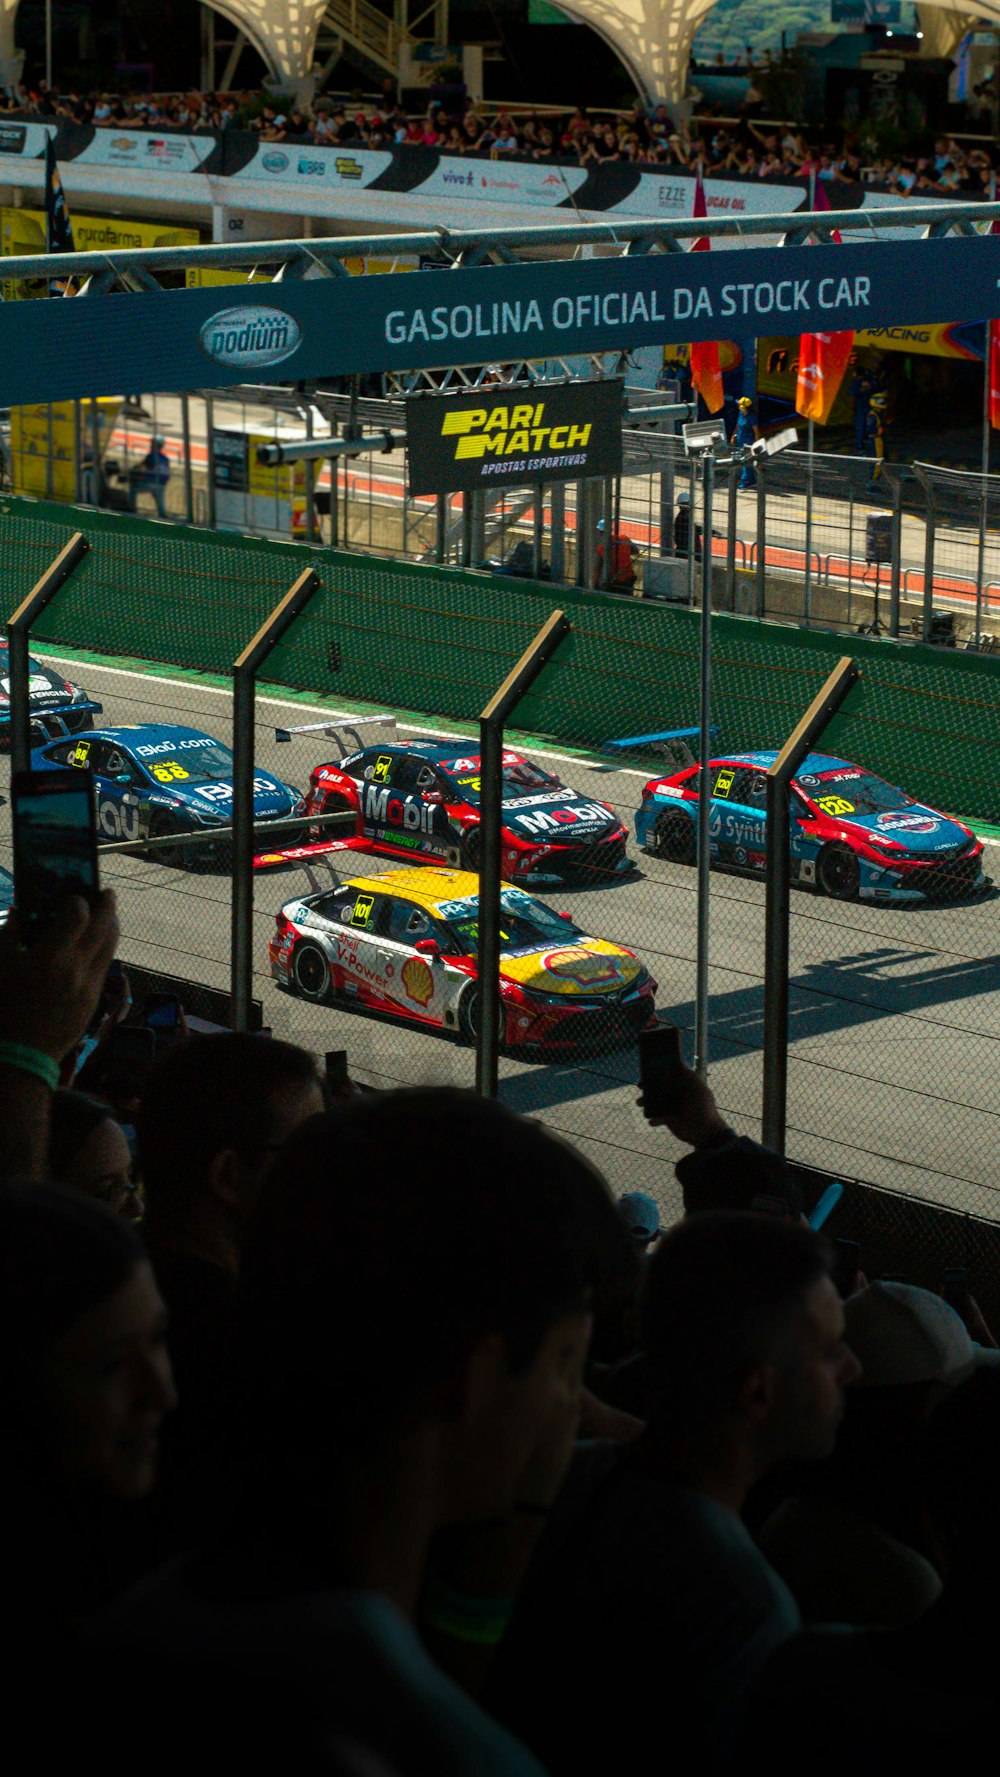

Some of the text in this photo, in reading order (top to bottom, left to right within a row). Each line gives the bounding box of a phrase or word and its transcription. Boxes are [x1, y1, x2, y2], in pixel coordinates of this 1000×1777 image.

[307, 161, 326, 175] BRB
[443, 171, 464, 184] vivo
[658, 186, 685, 202] EZZE
[706, 196, 746, 210] UCAS OIL
[77, 226, 142, 247] eurofarma
[384, 276, 871, 344] GASOLINA OFICIAL DA STOCK CAR
[211, 323, 288, 354] podium
[441, 402, 545, 436] PARI
[454, 424, 592, 460] MATCH
[481, 453, 588, 475] APOSTAS ESPORTIVAS
[75, 748, 87, 760] 88
[153, 765, 189, 782] 88
[376, 763, 388, 776] 91
[717, 779, 731, 790] 120
[365, 785, 437, 835] Mobil
[819, 799, 855, 816] 120
[514, 803, 615, 834] Mobil
[355, 903, 371, 918] 101
[339, 932, 361, 952] Shell
[337, 944, 389, 988] V-Power
